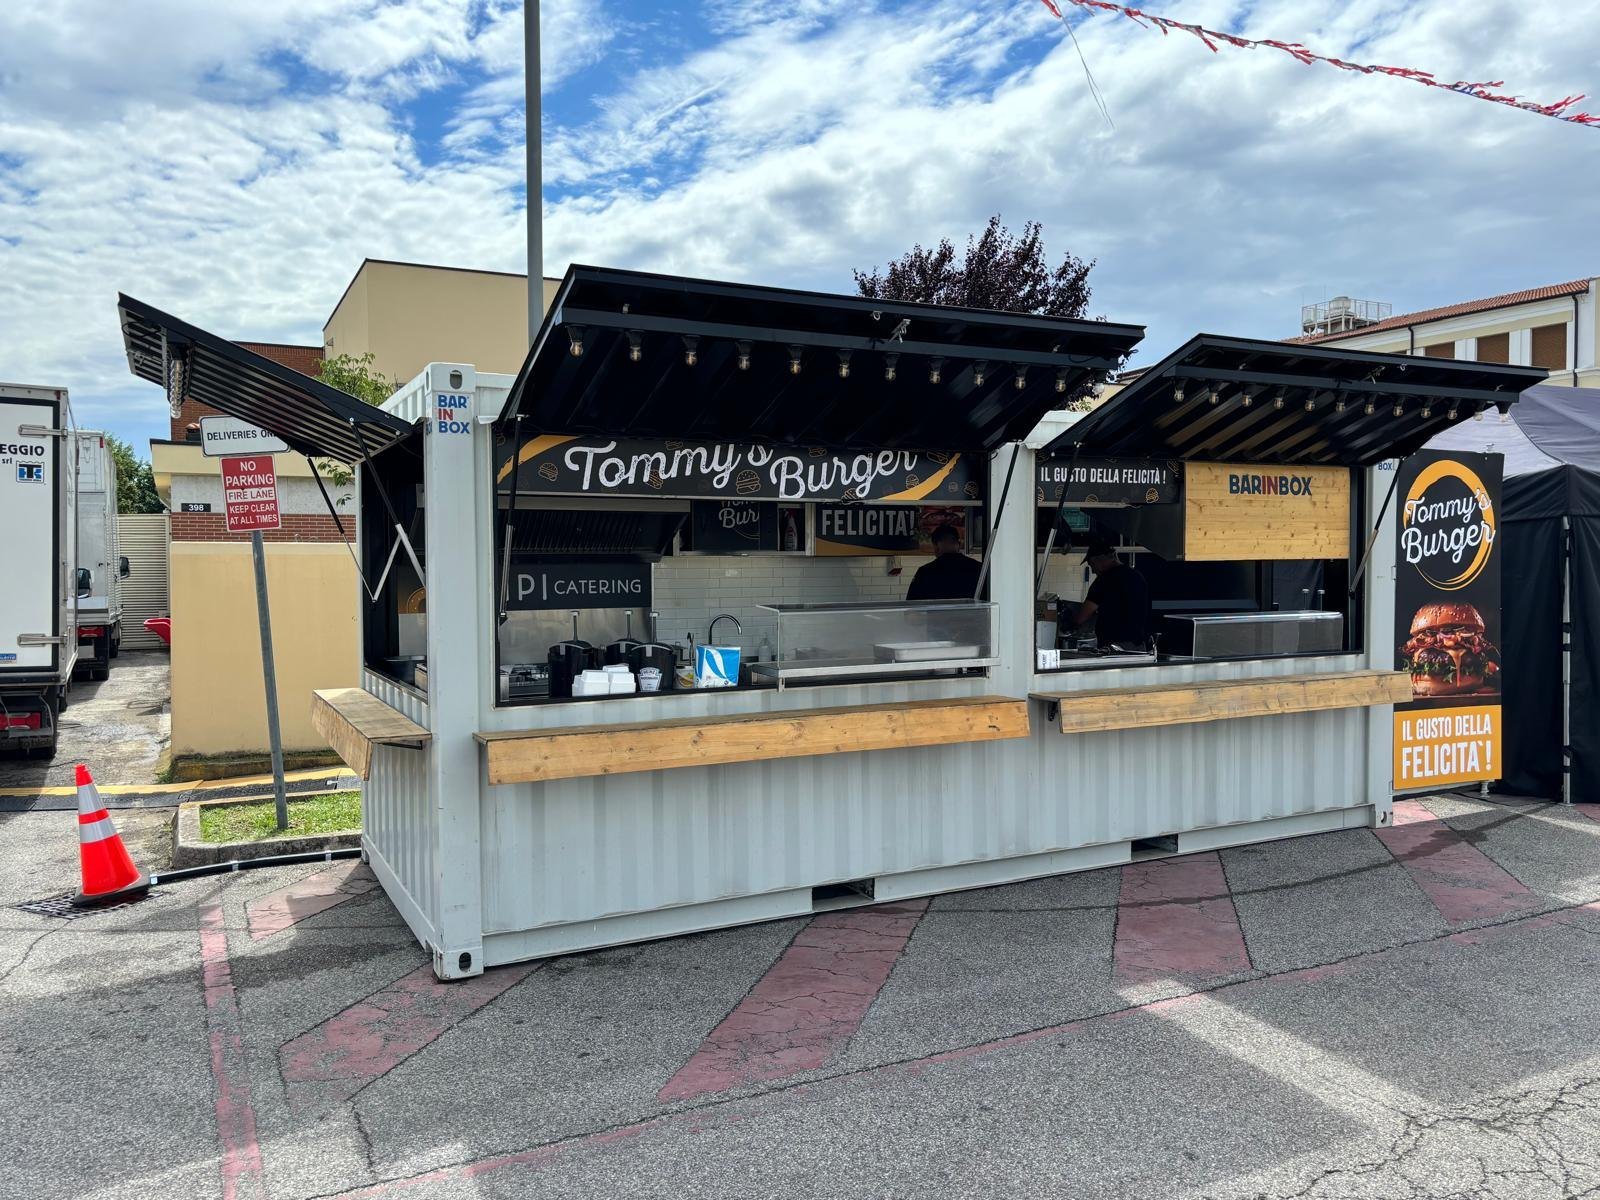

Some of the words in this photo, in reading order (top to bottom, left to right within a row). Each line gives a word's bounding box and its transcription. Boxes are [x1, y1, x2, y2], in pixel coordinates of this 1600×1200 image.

[438, 395, 467, 408] BAR
[438, 408, 453, 421] IN
[438, 421, 470, 434] BOX
[207, 429, 257, 441] DELIVERIES
[240, 460, 256, 471] NO
[564, 440, 773, 490] Tommys
[769, 449, 918, 499] Burger
[1378, 462, 1393, 471] BOX
[225, 474, 274, 487] PARKING
[1040, 467, 1051, 482] IL
[1090, 468, 1120, 484] DELLA
[228, 490, 248, 500] FIRE
[250, 489, 274, 499] LANE
[229, 504, 248, 514] KEEP
[250, 503, 276, 513] CLEAR
[1404, 487, 1492, 525] Tommy's
[229, 516, 239, 525] AT
[240, 515, 255, 524] ALL
[255, 514, 278, 523] TIMES
[1401, 520, 1496, 564] Burger
[554, 579, 642, 595] CATERING
[1402, 720, 1413, 741] IL
[1415, 717, 1452, 741] GUSTO
[1455, 713, 1492, 737] DELLA
